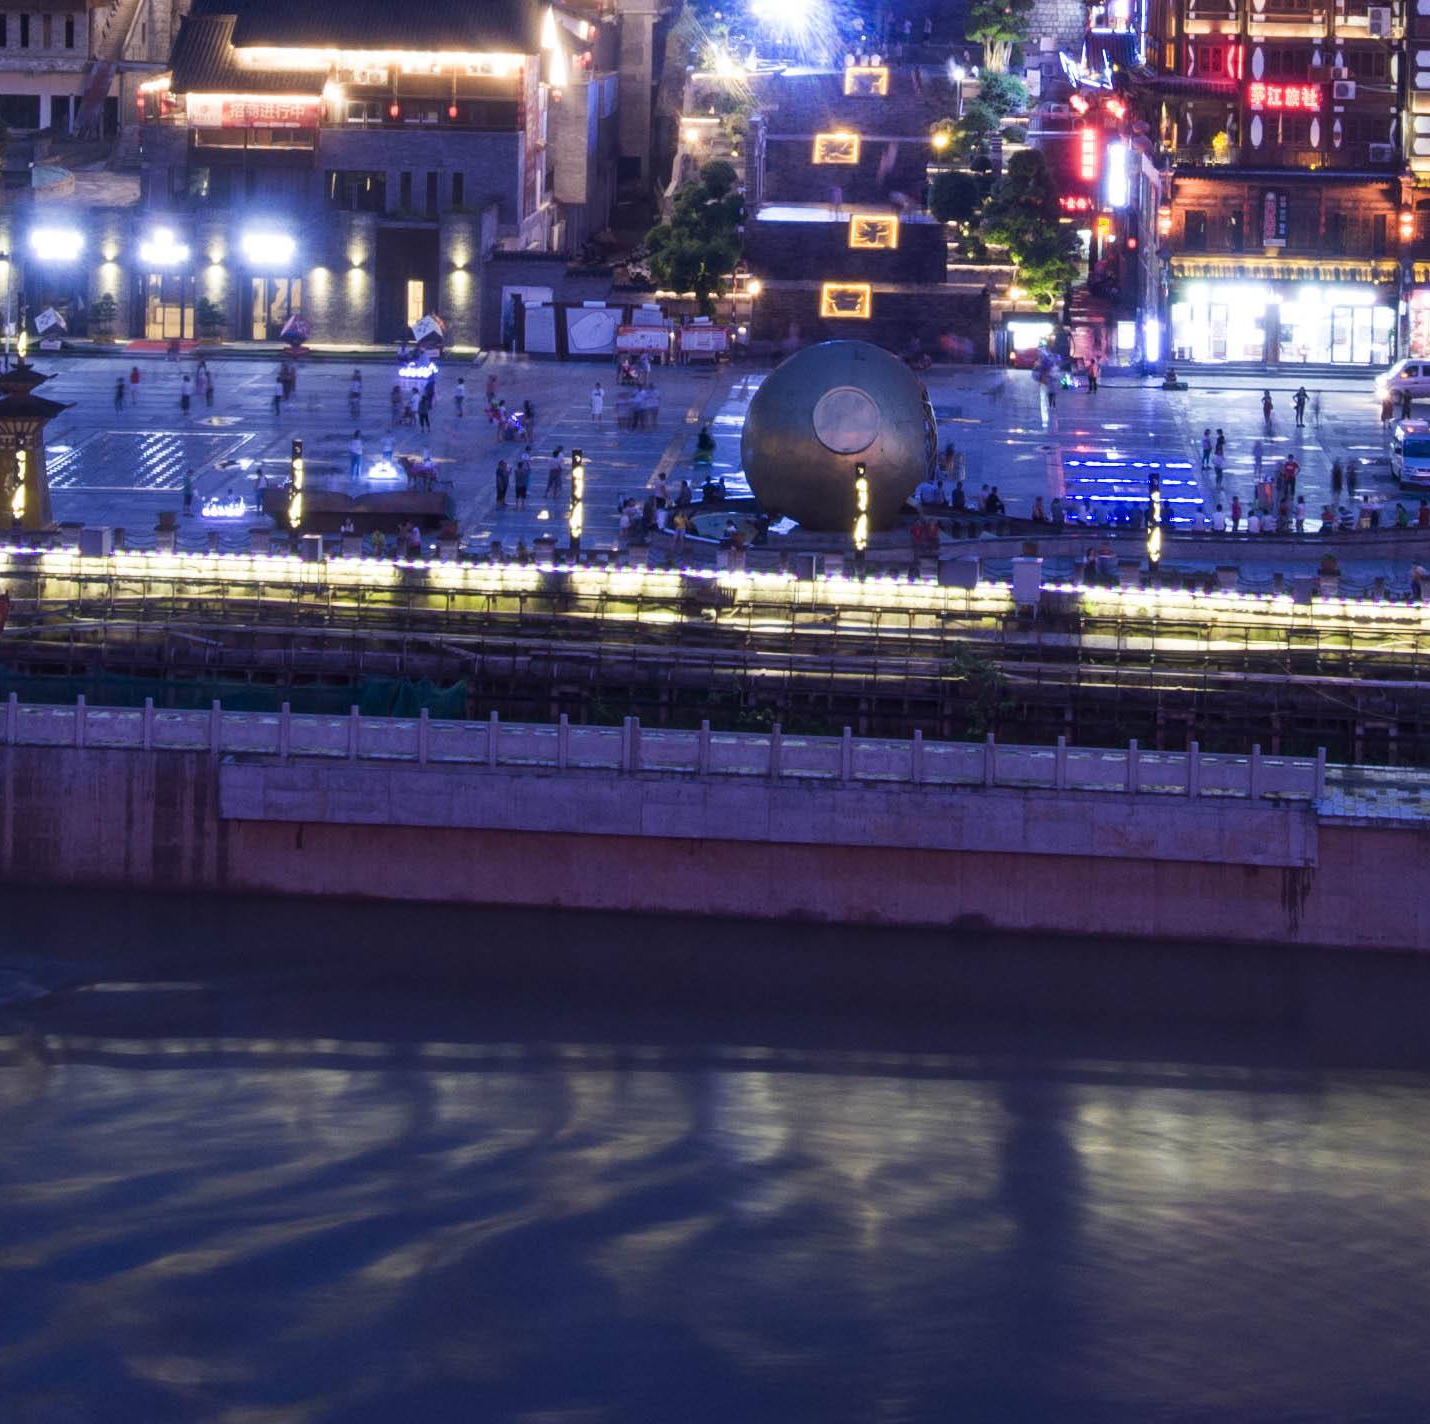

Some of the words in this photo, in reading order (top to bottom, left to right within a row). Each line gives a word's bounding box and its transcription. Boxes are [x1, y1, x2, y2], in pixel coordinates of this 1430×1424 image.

[229, 103, 304, 119] 招商进行中
